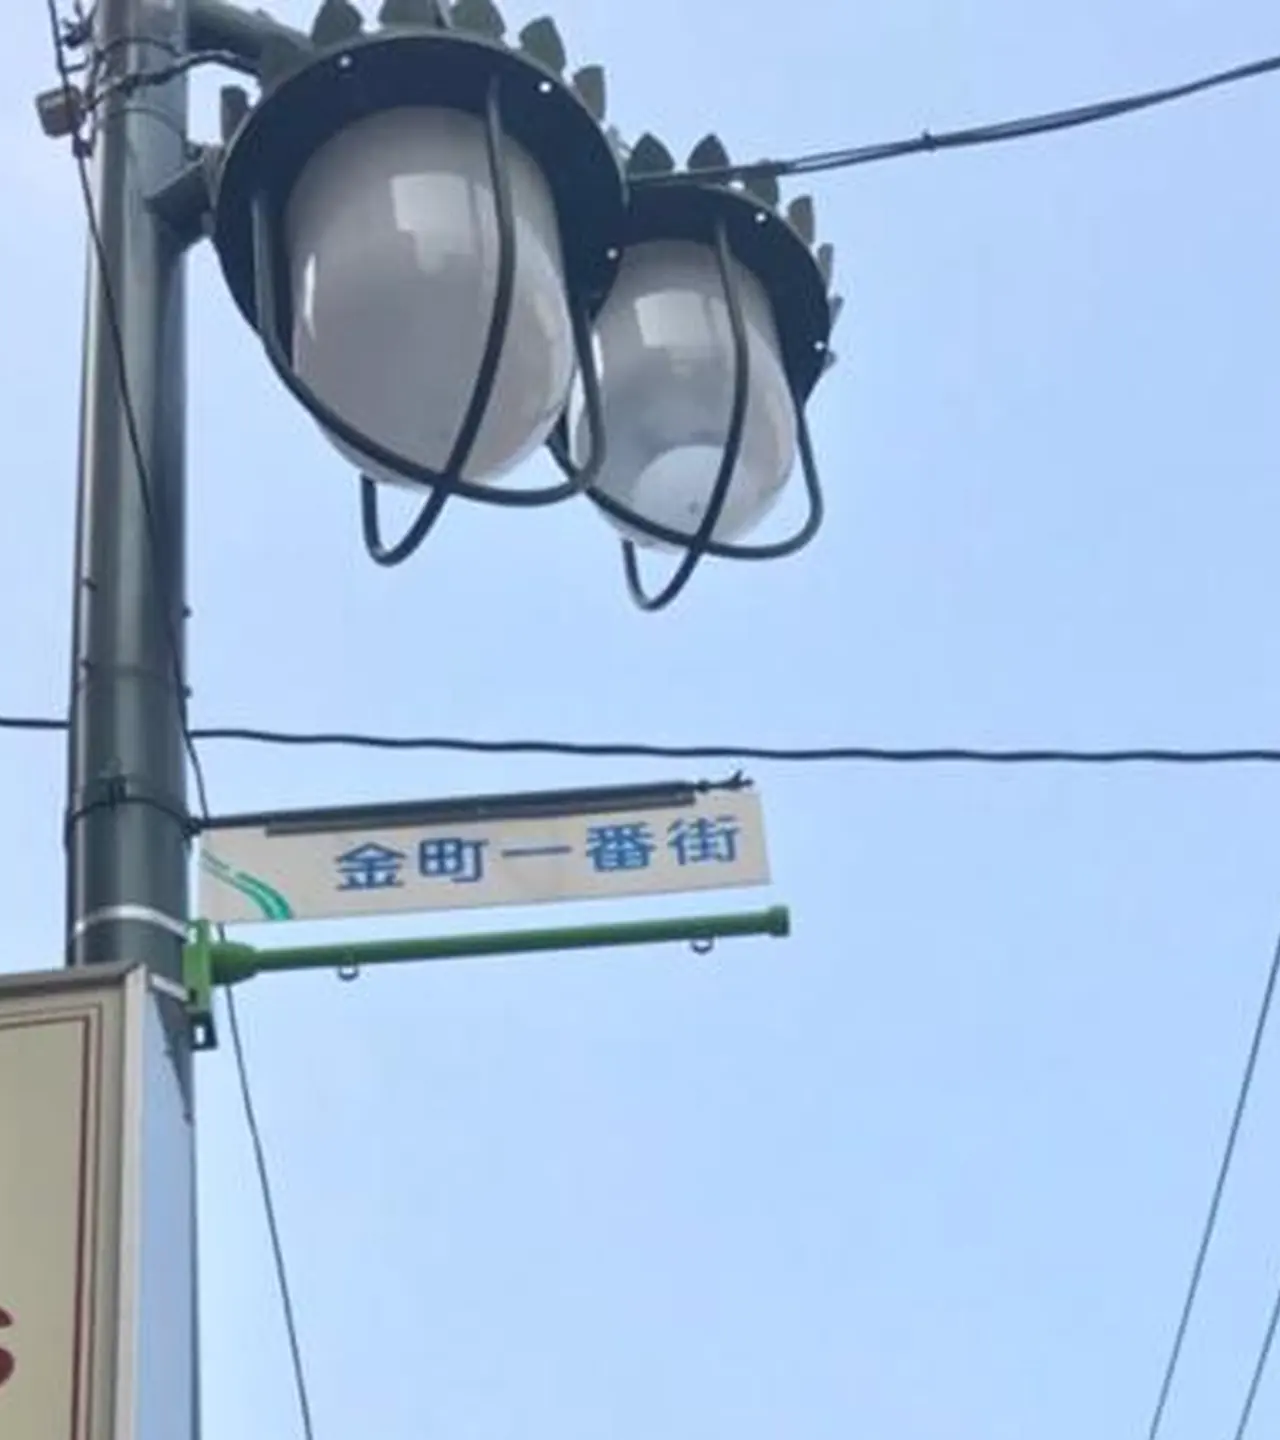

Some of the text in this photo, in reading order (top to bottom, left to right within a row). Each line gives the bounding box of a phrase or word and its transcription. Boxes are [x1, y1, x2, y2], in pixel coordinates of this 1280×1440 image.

[336, 815, 743, 891] 金町一番街
